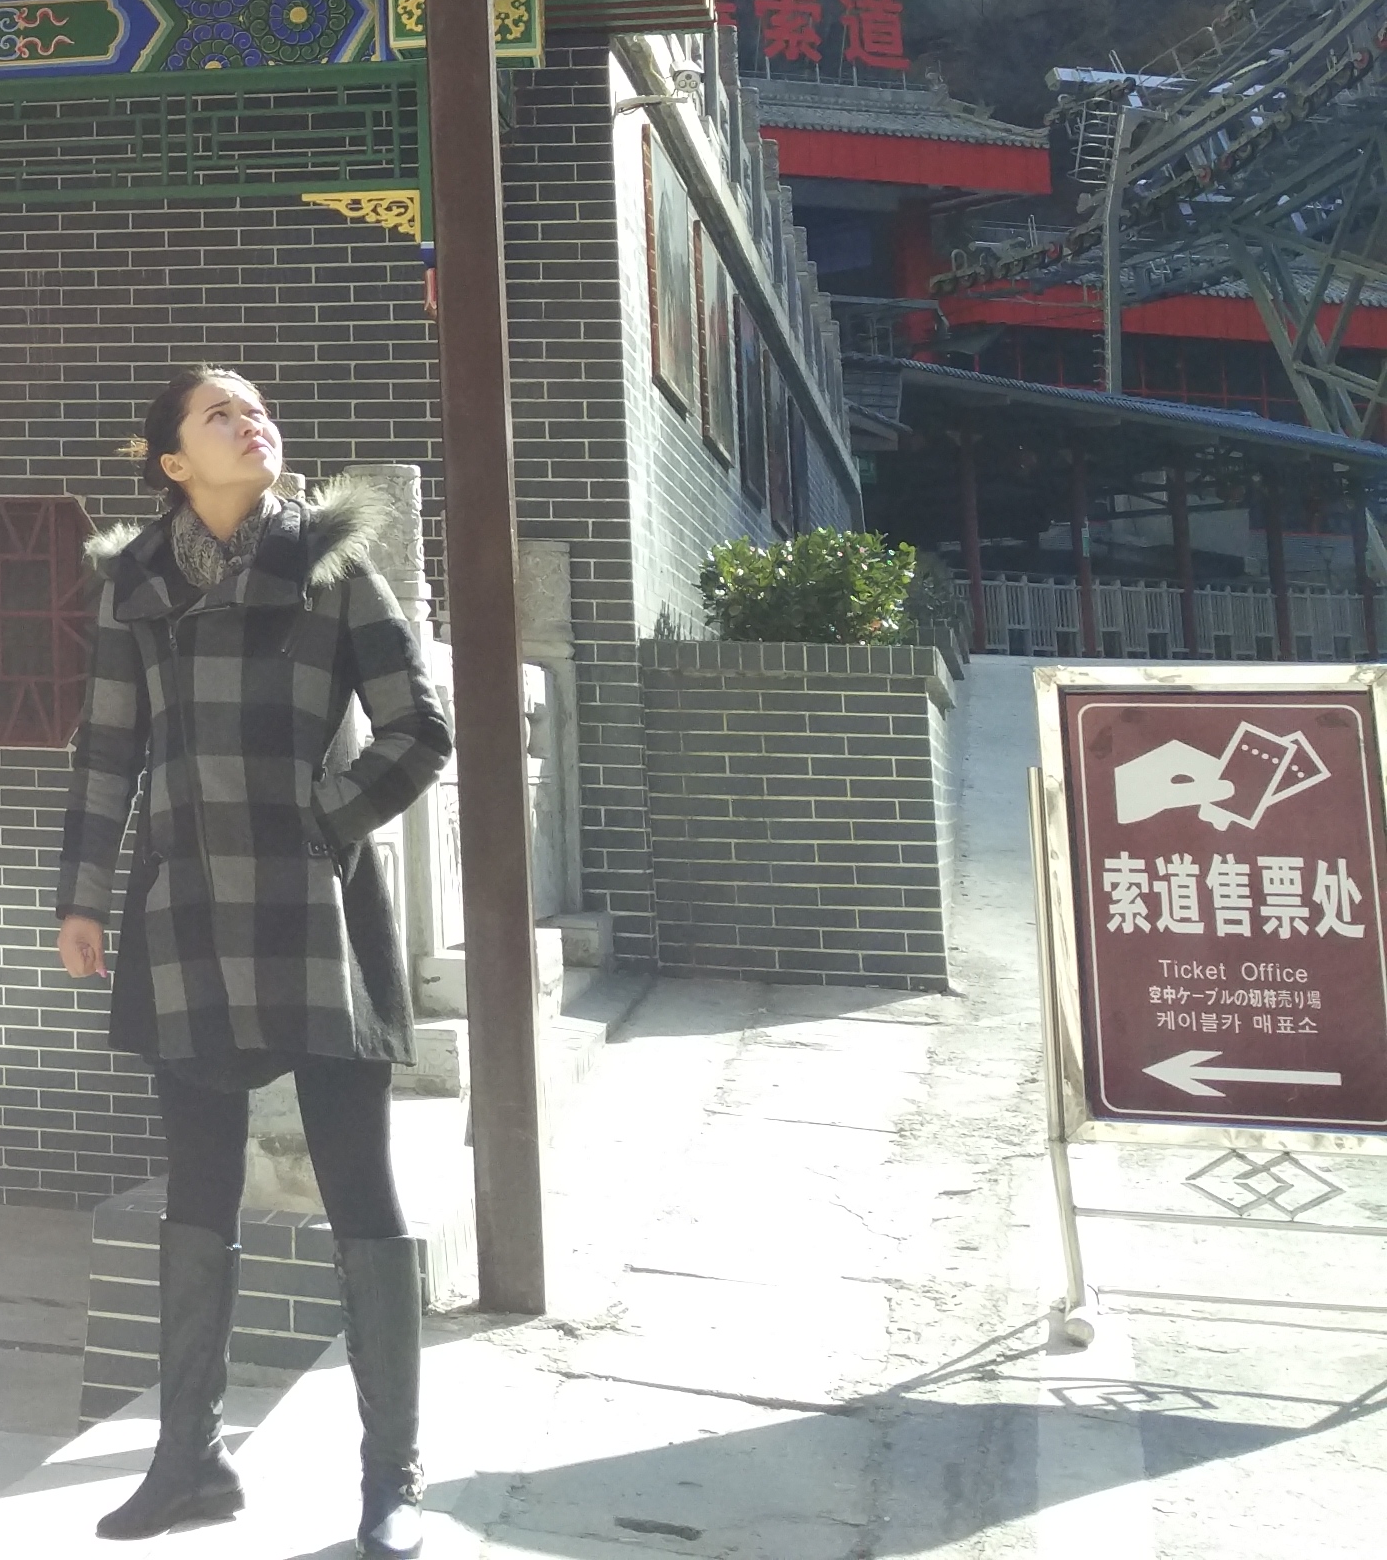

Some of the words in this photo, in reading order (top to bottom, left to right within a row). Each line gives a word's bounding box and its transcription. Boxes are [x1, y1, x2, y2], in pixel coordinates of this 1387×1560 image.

[1102, 851, 1366, 940] 索道售票处
[1158, 959, 1227, 981] Ticket
[1241, 962, 1308, 983] Office
[1156, 1010, 1242, 1034] 케이블카
[1253, 1013, 1319, 1035] 매표소
